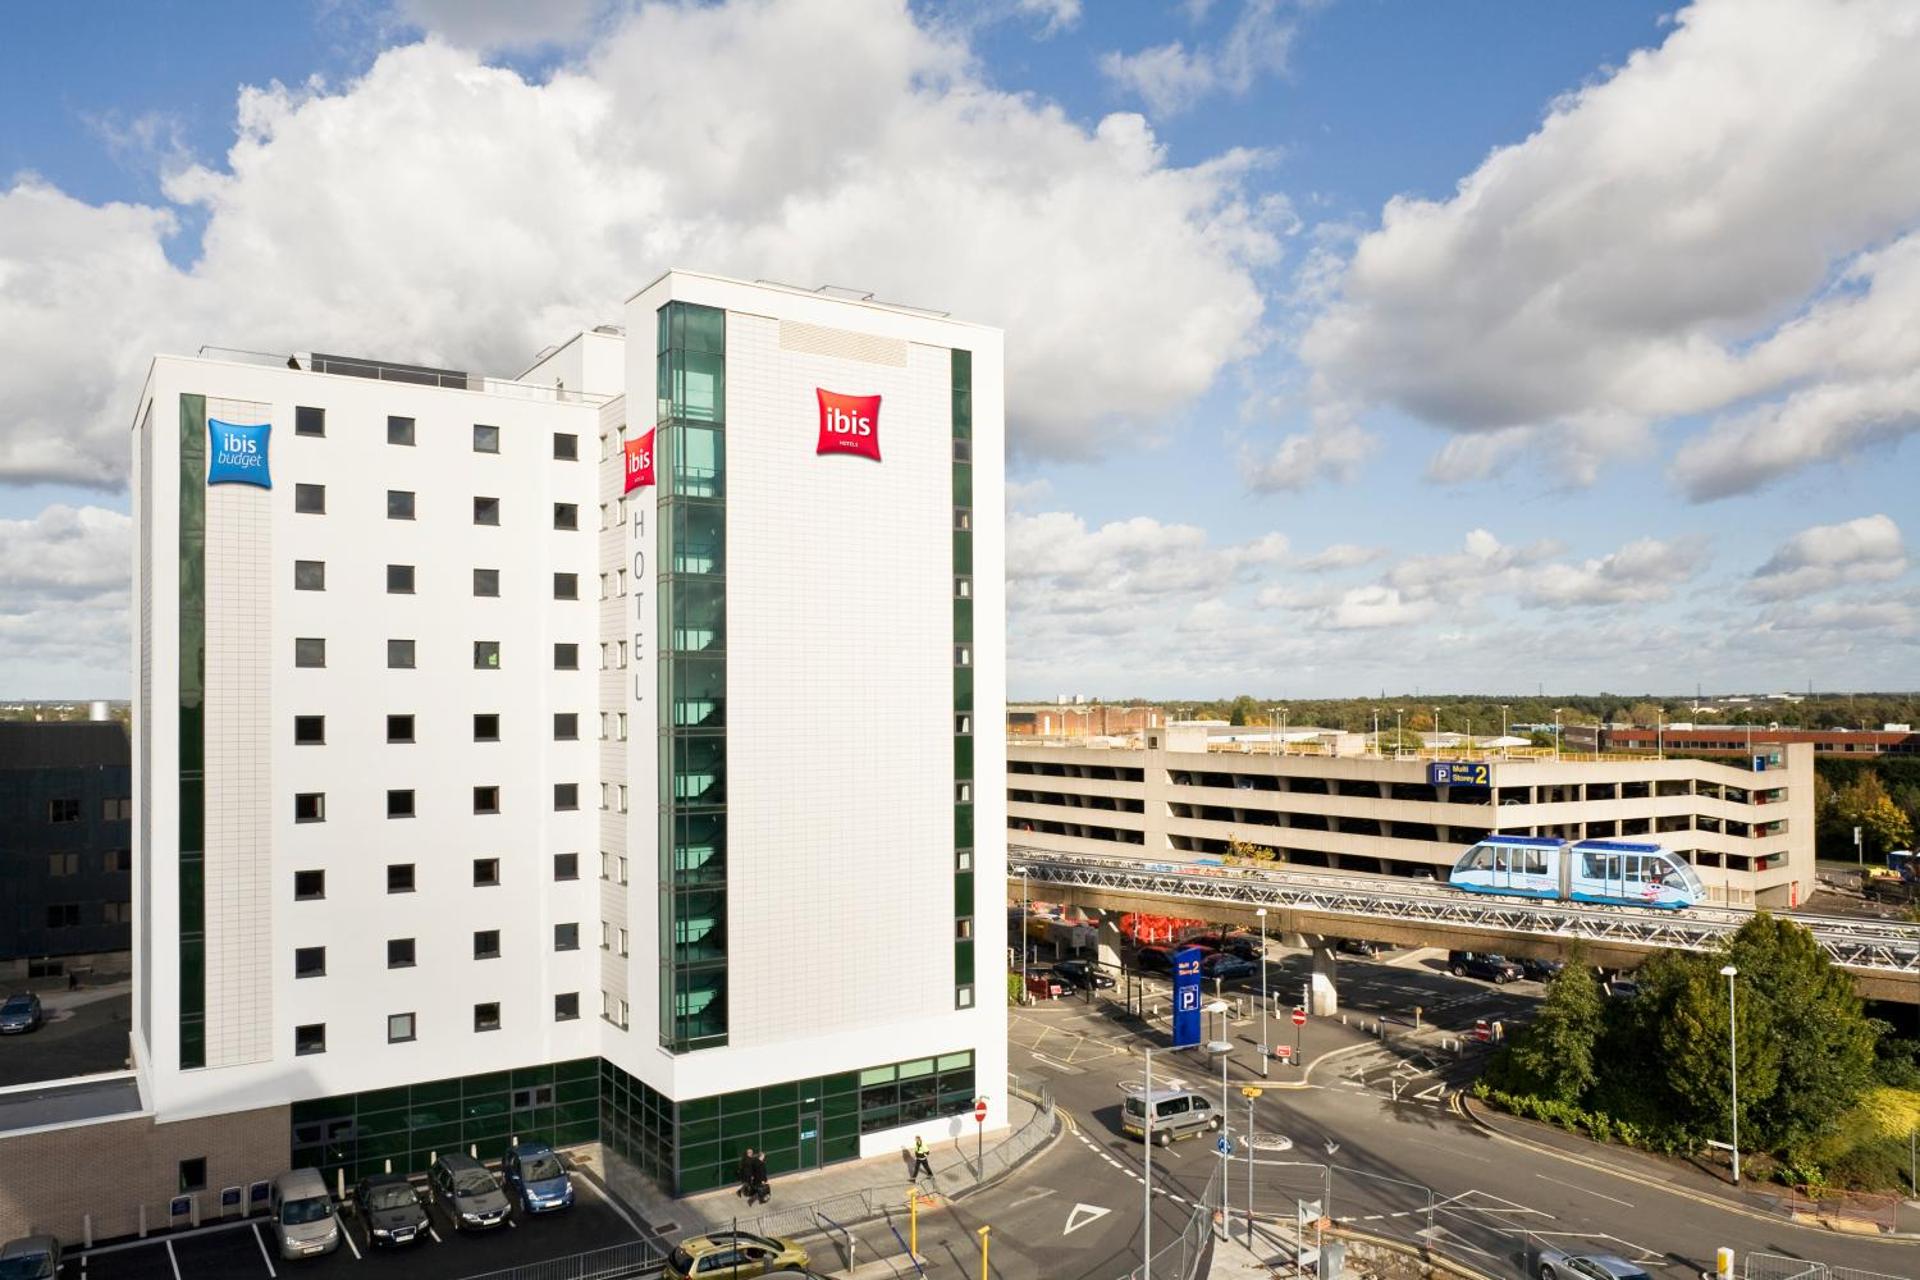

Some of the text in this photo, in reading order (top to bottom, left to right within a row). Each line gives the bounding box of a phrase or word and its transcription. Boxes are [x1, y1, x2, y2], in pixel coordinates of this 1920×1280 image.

[827, 406, 871, 437] ibis
[224, 432, 257, 454] ibis
[218, 450, 264, 469] budget
[628, 448, 651, 474] ibis
[634, 509, 645, 702] HOTEL
[1438, 769, 1447, 782] P
[1452, 765, 1469, 773] Multi
[1475, 766, 1487, 784] 2
[1452, 774, 1475, 784] Storey
[1192, 960, 1200, 974] 2
[1183, 992, 1194, 1009] P
